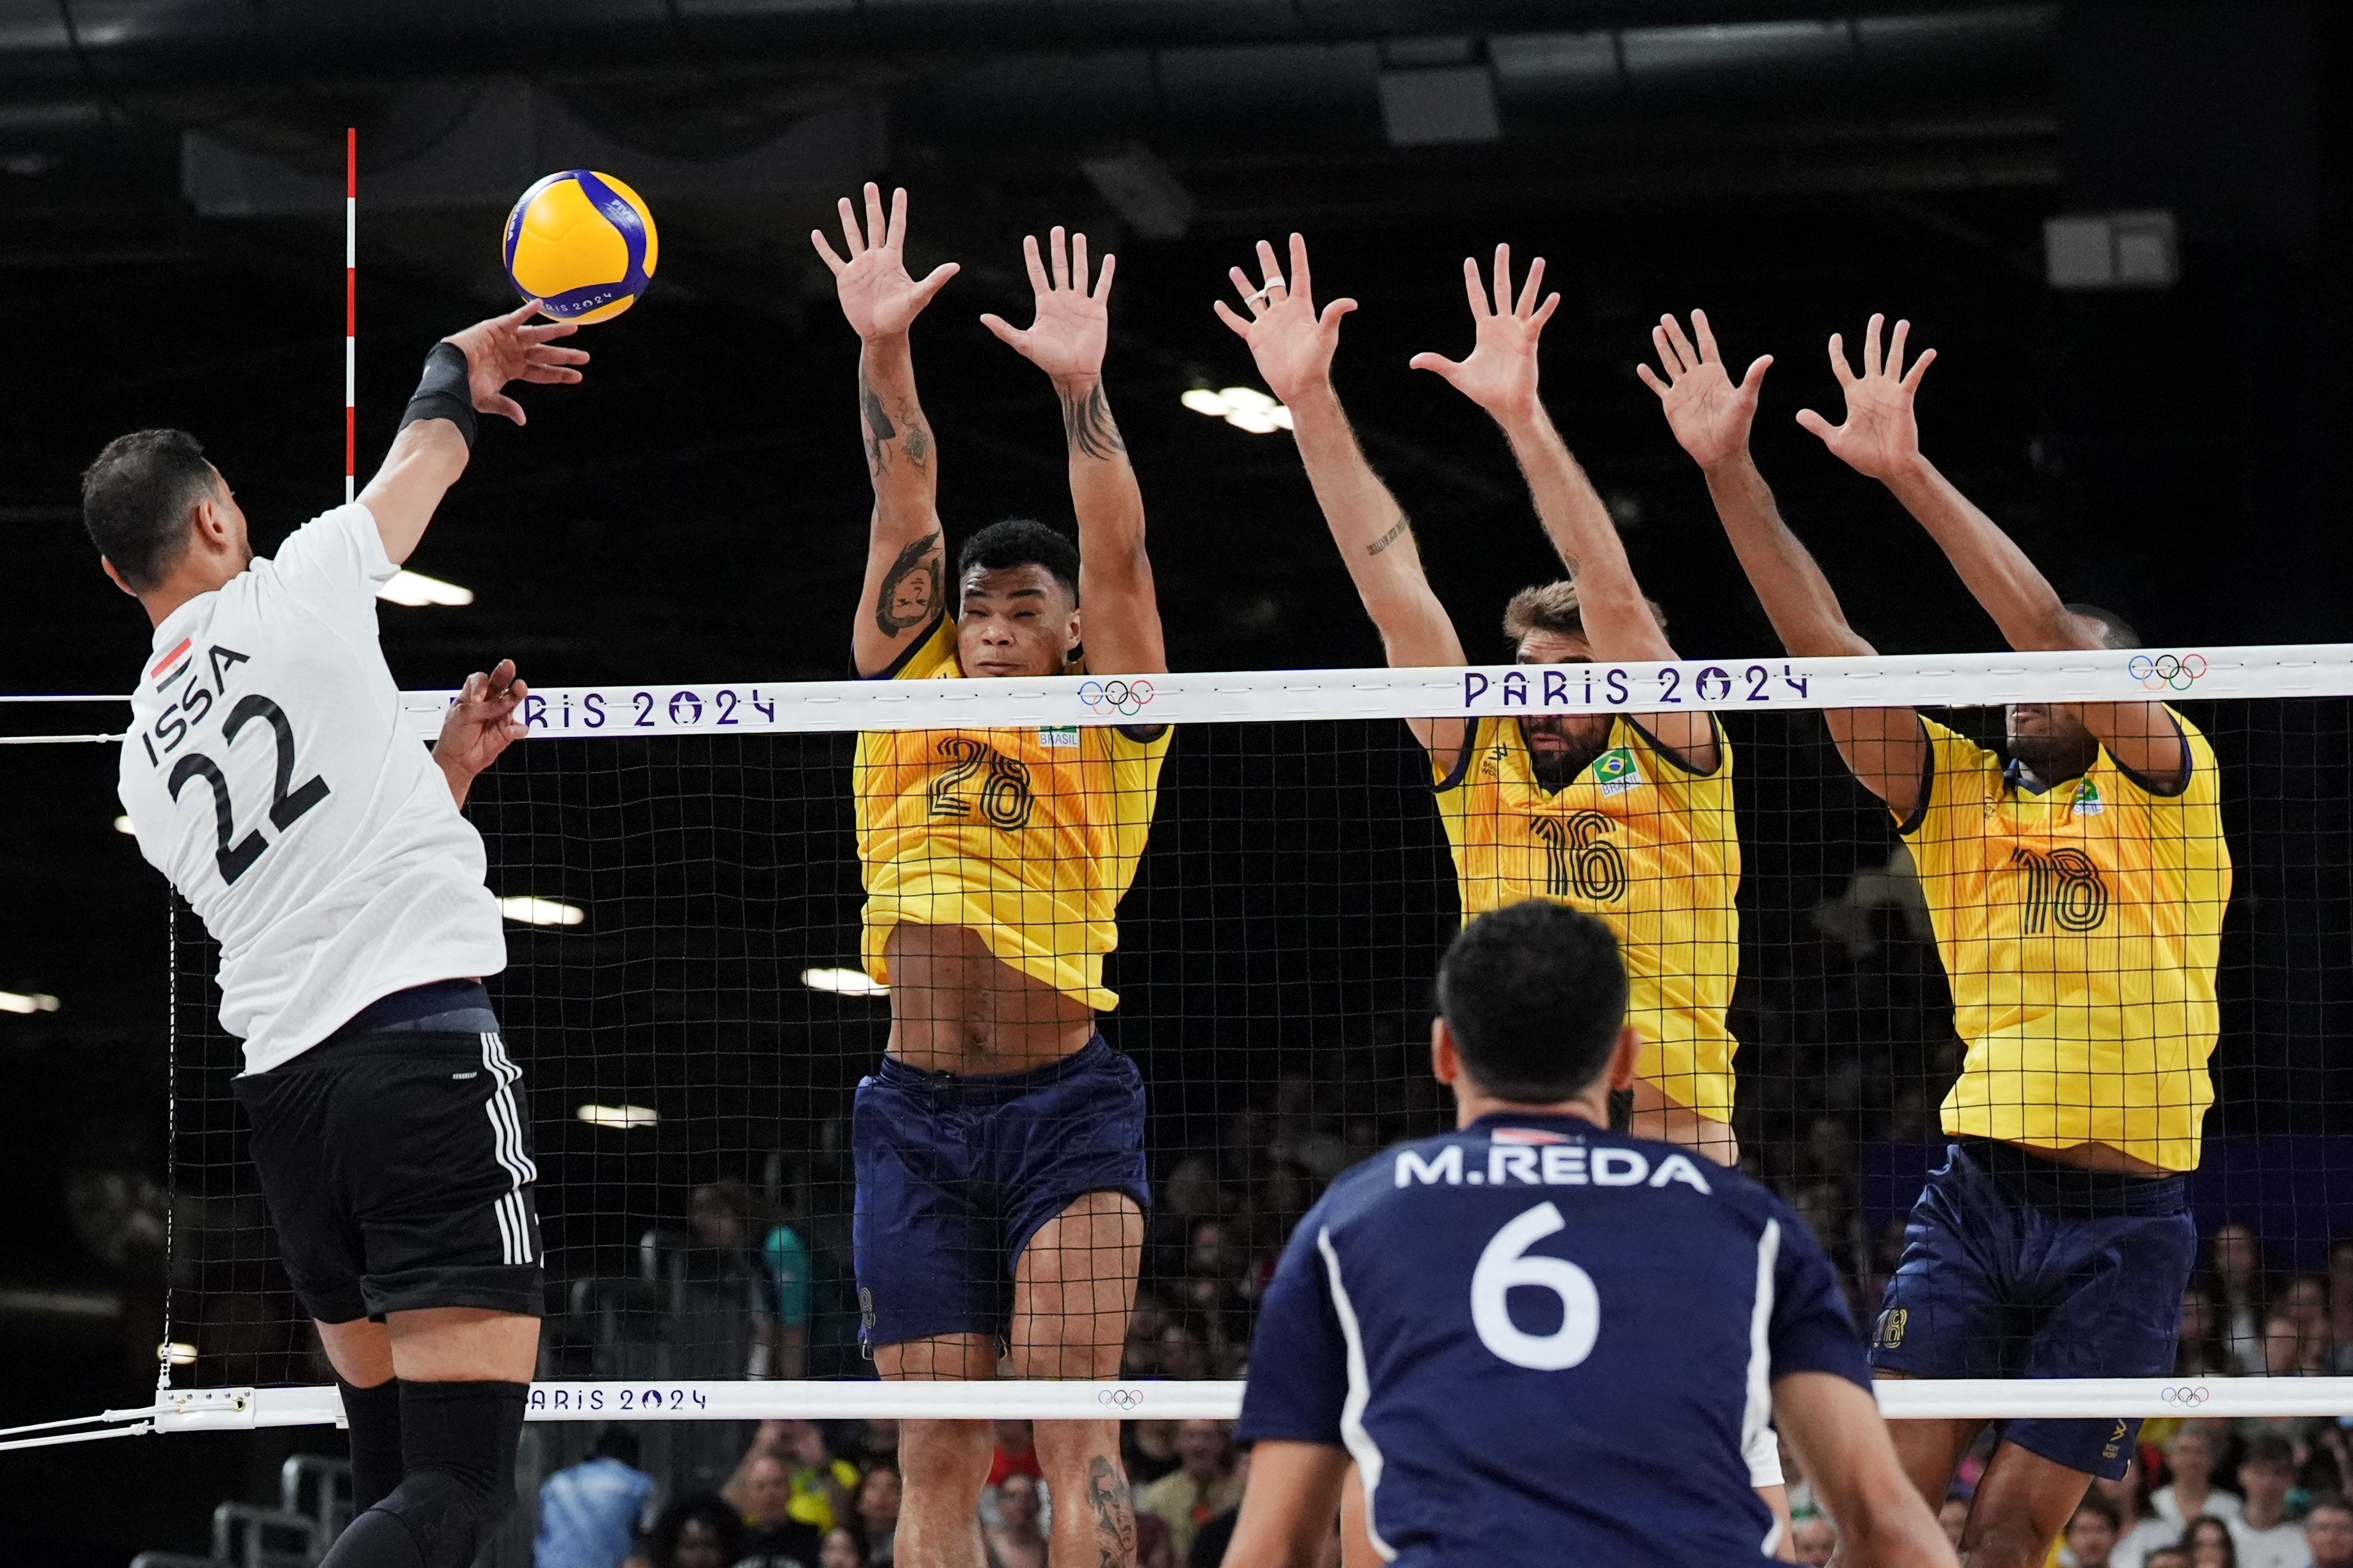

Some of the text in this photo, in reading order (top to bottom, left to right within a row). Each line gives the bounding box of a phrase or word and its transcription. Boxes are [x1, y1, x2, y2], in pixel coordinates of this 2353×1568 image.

[142, 645, 250, 768] ISSA
[634, 689, 775, 727] 2024
[1658, 665, 1808, 703] 2024
[1040, 734, 1077, 745] BRASIL
[167, 694, 331, 886] 22
[928, 737, 1034, 831] 28
[1530, 810, 1626, 902] 16
[2010, 847, 2109, 935] 18
[1394, 1144, 1713, 1195] M.REDA
[1471, 1201, 1600, 1371] 6
[620, 1389, 706, 1410] 2024
